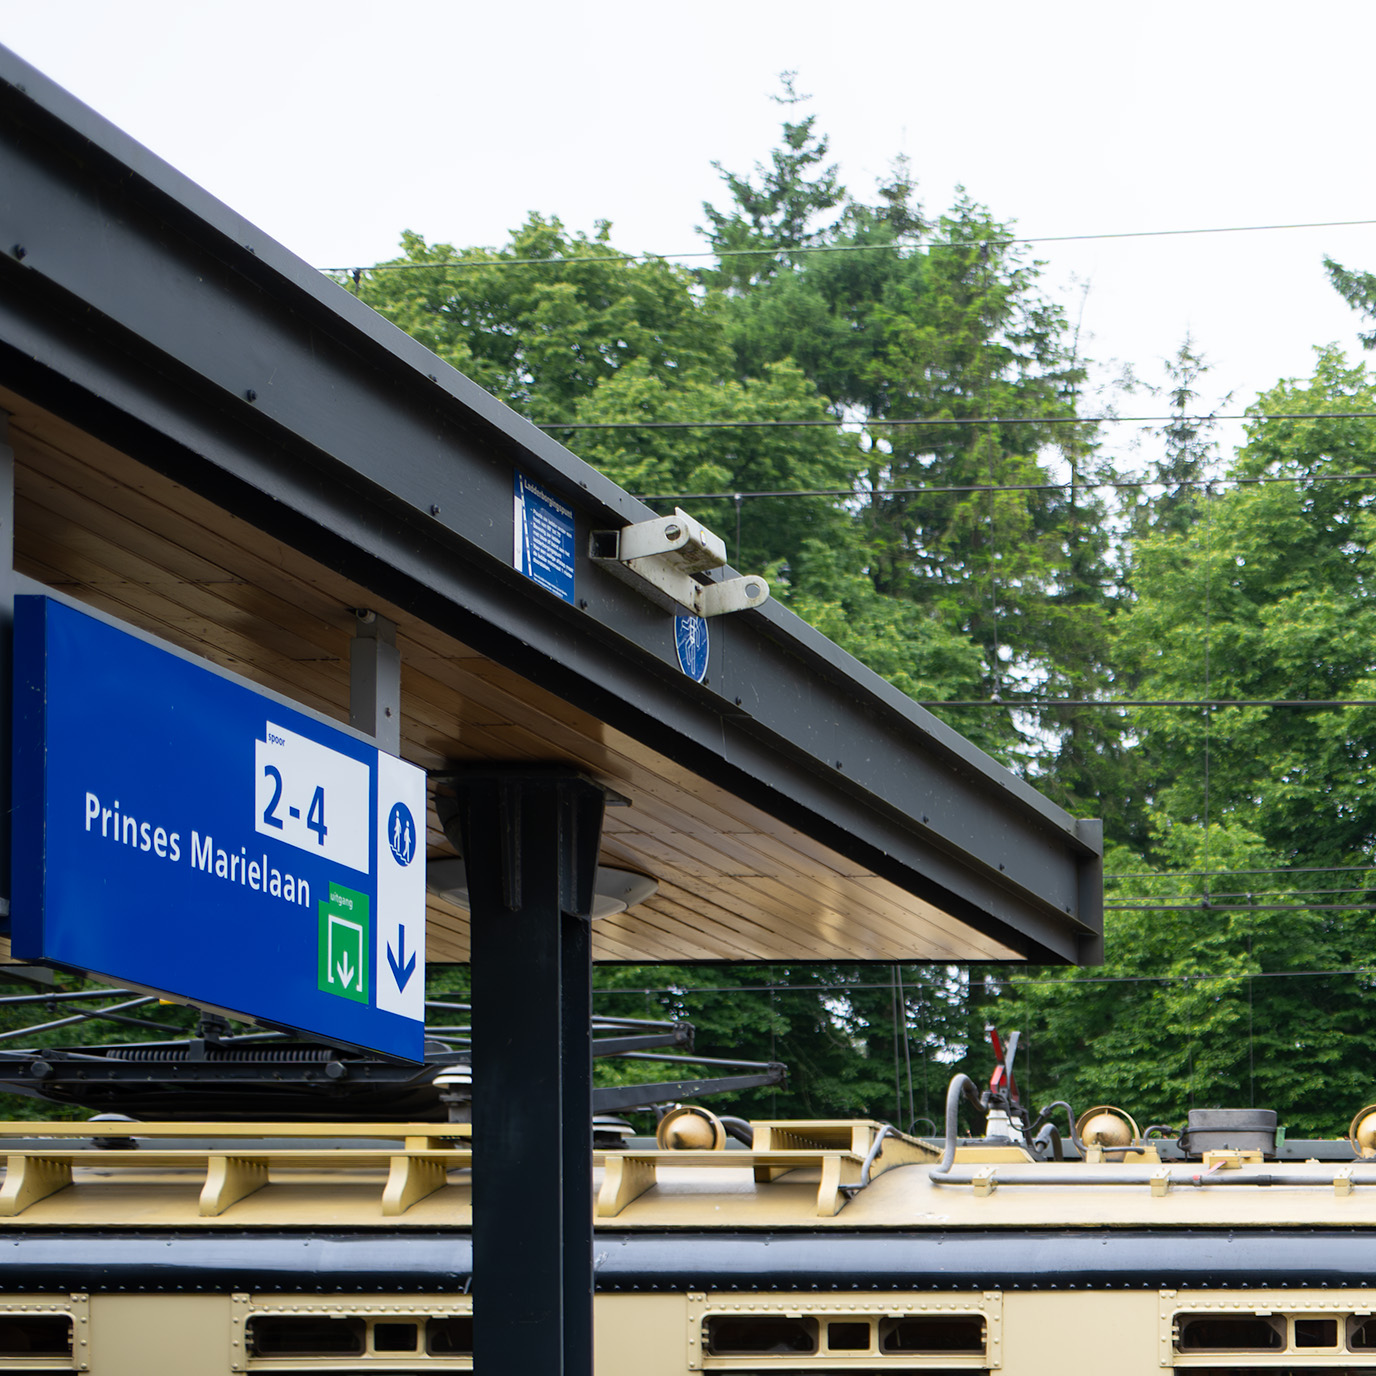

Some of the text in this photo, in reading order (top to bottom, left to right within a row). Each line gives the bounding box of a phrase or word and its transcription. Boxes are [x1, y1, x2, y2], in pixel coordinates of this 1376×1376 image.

[268, 733, 285, 747] spoor
[263, 764, 328, 846] 2-4
[85, 791, 310, 908] Prinses Marielaan
[329, 892, 353, 911] uitgang
